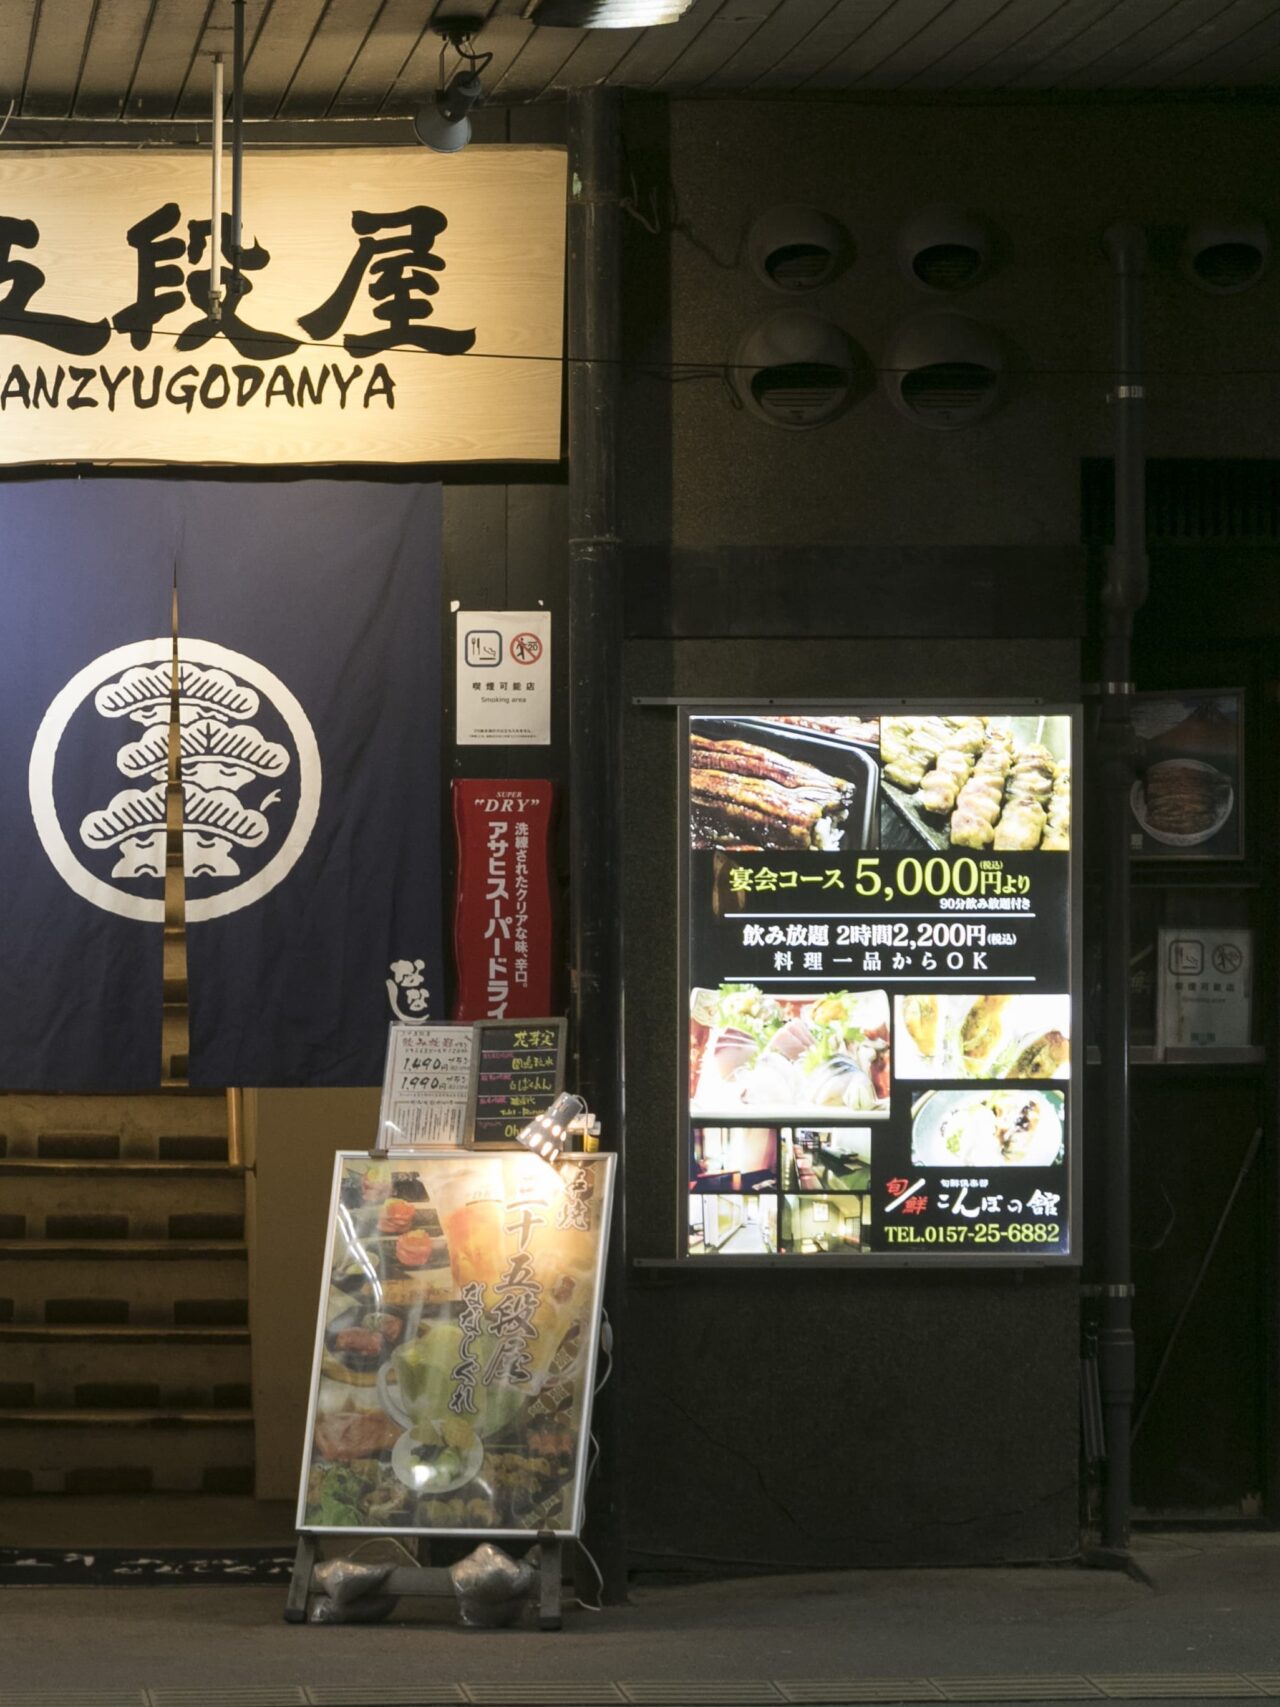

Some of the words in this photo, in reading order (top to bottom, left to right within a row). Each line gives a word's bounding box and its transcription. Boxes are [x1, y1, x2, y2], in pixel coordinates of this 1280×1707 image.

[471, 681, 536, 692] 喫煙可能店
[480, 696, 510, 705] Smoking
[496, 791, 523, 799] SUPER
[729, 865, 846, 893] 宴会コース
[854, 856, 1031, 902] 5,000円より
[939, 897, 1032, 911] 90分飲み放題付き
[483, 821, 514, 1020] アサヒスーパードライ
[742, 924, 829, 948] 飲み放題
[883, 1222, 1061, 1245] TEL.0157-25-6882
[482, 1176, 548, 1388] 三十五段屋
[448, 1280, 488, 1415] ななしぐれ
